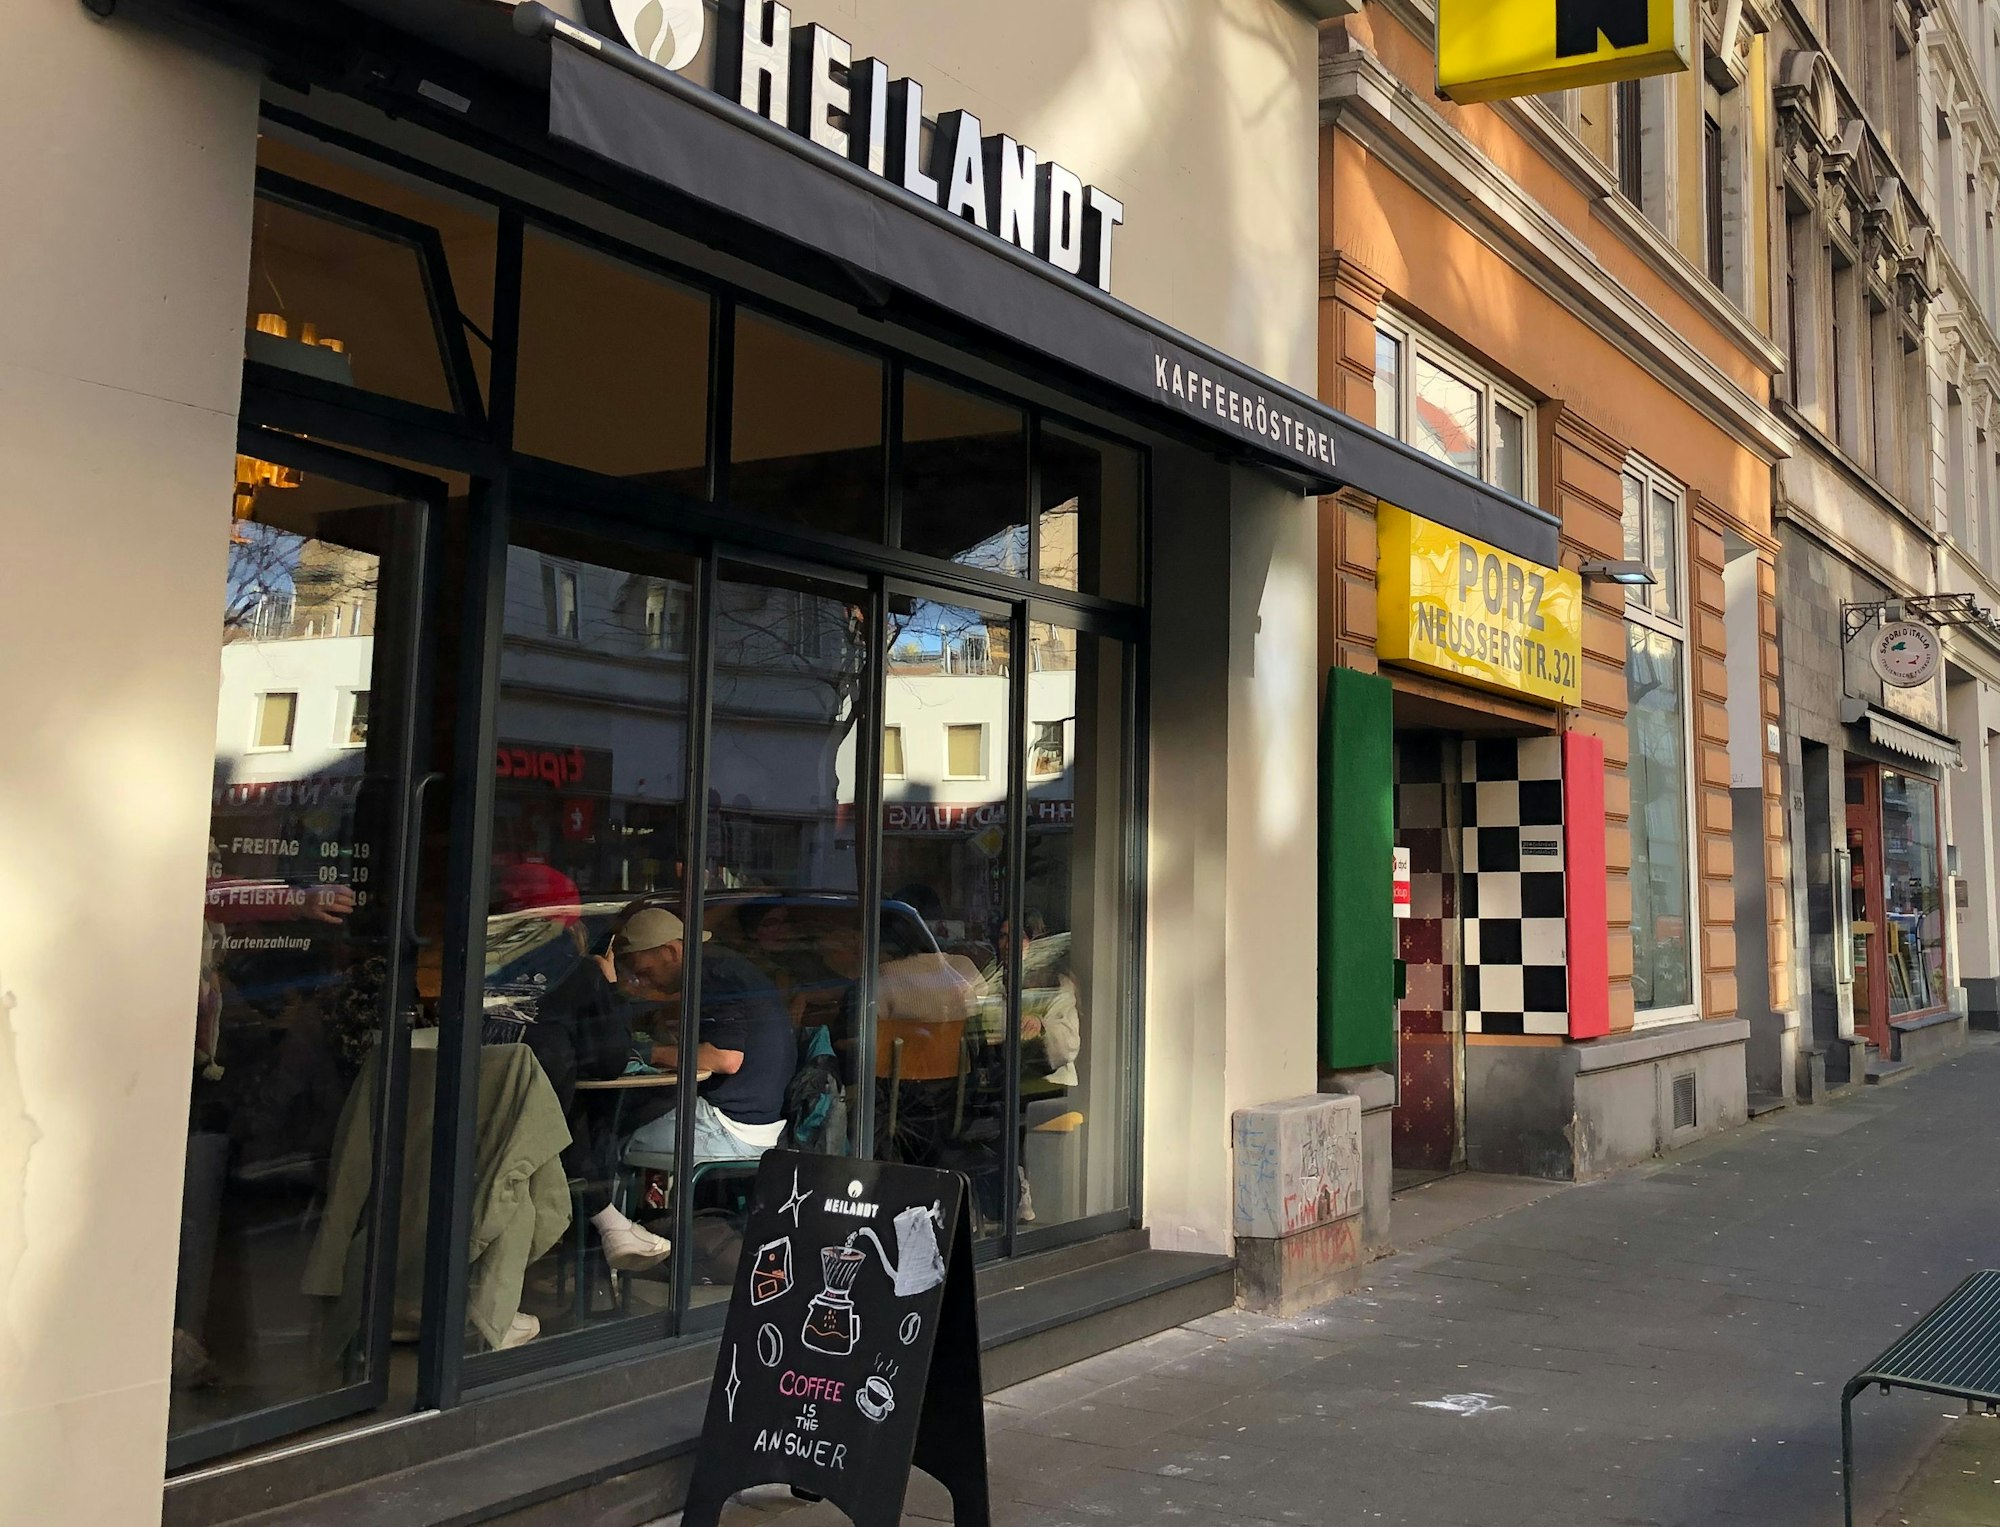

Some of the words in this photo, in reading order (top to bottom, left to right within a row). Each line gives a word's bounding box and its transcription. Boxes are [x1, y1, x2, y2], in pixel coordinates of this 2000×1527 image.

[738, 0, 1124, 293] HEILANDT
[1154, 354, 1337, 467] KAFFEERÖSTEREI
[1458, 540, 1545, 632] PORZ
[1880, 629, 1902, 654] SAPORI
[231, 837, 300, 856] FREITAG
[320, 841, 339, 858] 08
[353, 843, 370, 859] 19
[318, 865, 338, 882] 09
[351, 866, 369, 882] 19
[228, 889, 306, 906] FEIERTAG
[221, 935, 312, 951] Kartenzahlung
[824, 1197, 879, 1219] HEILANDT
[779, 1369, 845, 1403] COFFEE
[801, 1403, 817, 1419] IS
[795, 1416, 819, 1431] THE
[753, 1428, 848, 1470] ANSWER
